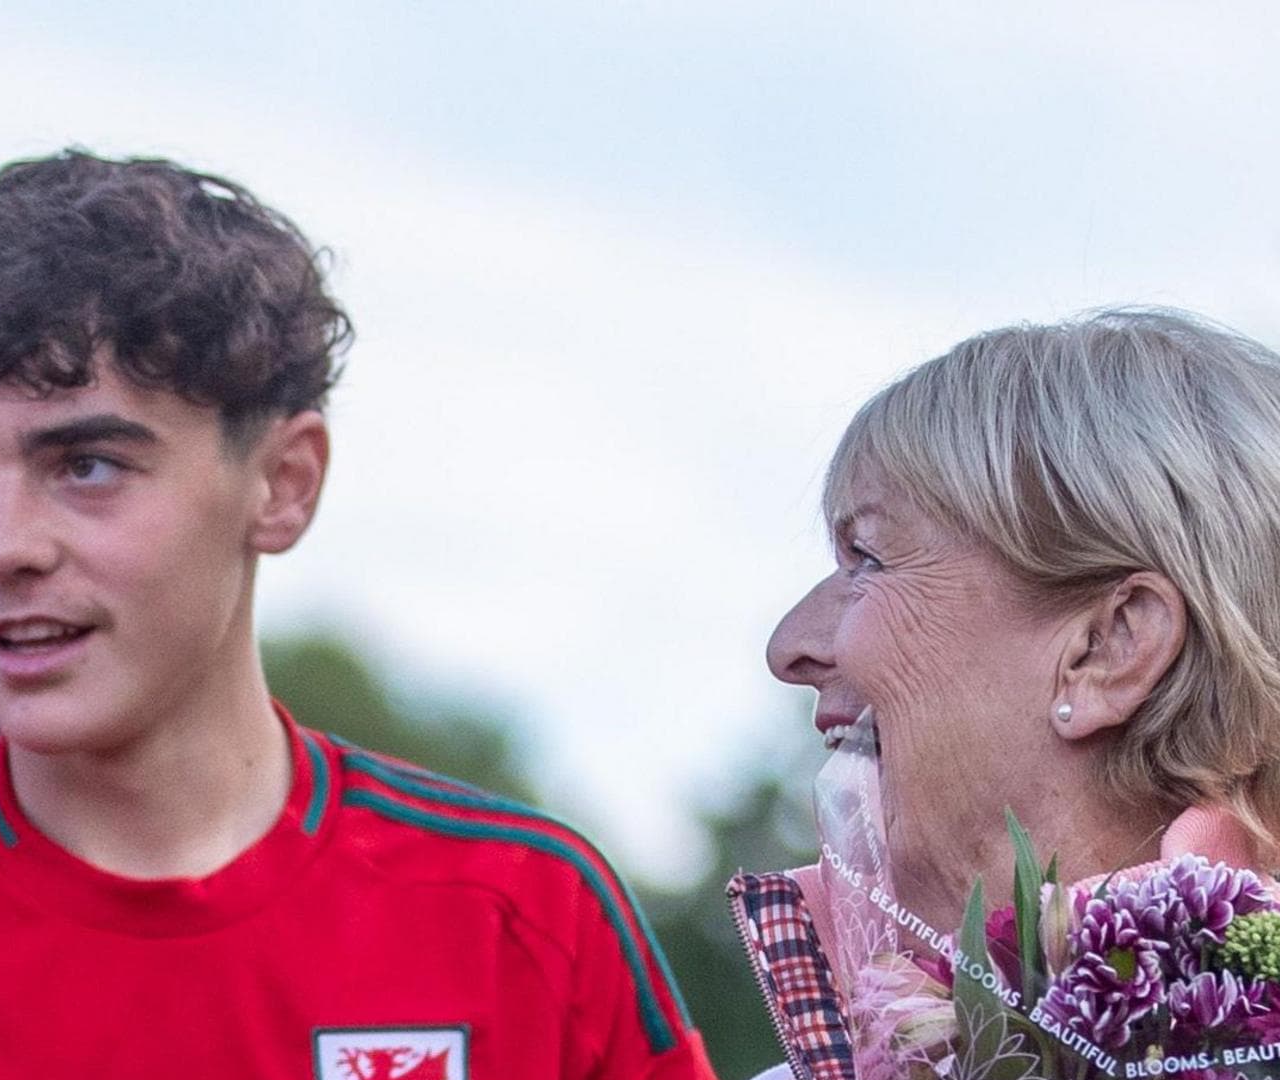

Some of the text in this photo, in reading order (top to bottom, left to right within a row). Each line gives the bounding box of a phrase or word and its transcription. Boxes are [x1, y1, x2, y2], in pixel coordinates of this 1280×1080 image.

[821, 842, 863, 889] OOMS
[869, 888, 955, 957] BEAUTIFUL
[952, 949, 1022, 1008] BLOOMS
[1029, 1007, 1118, 1077] BEAUTIFUL
[1125, 1055, 1208, 1079] BLOOMS
